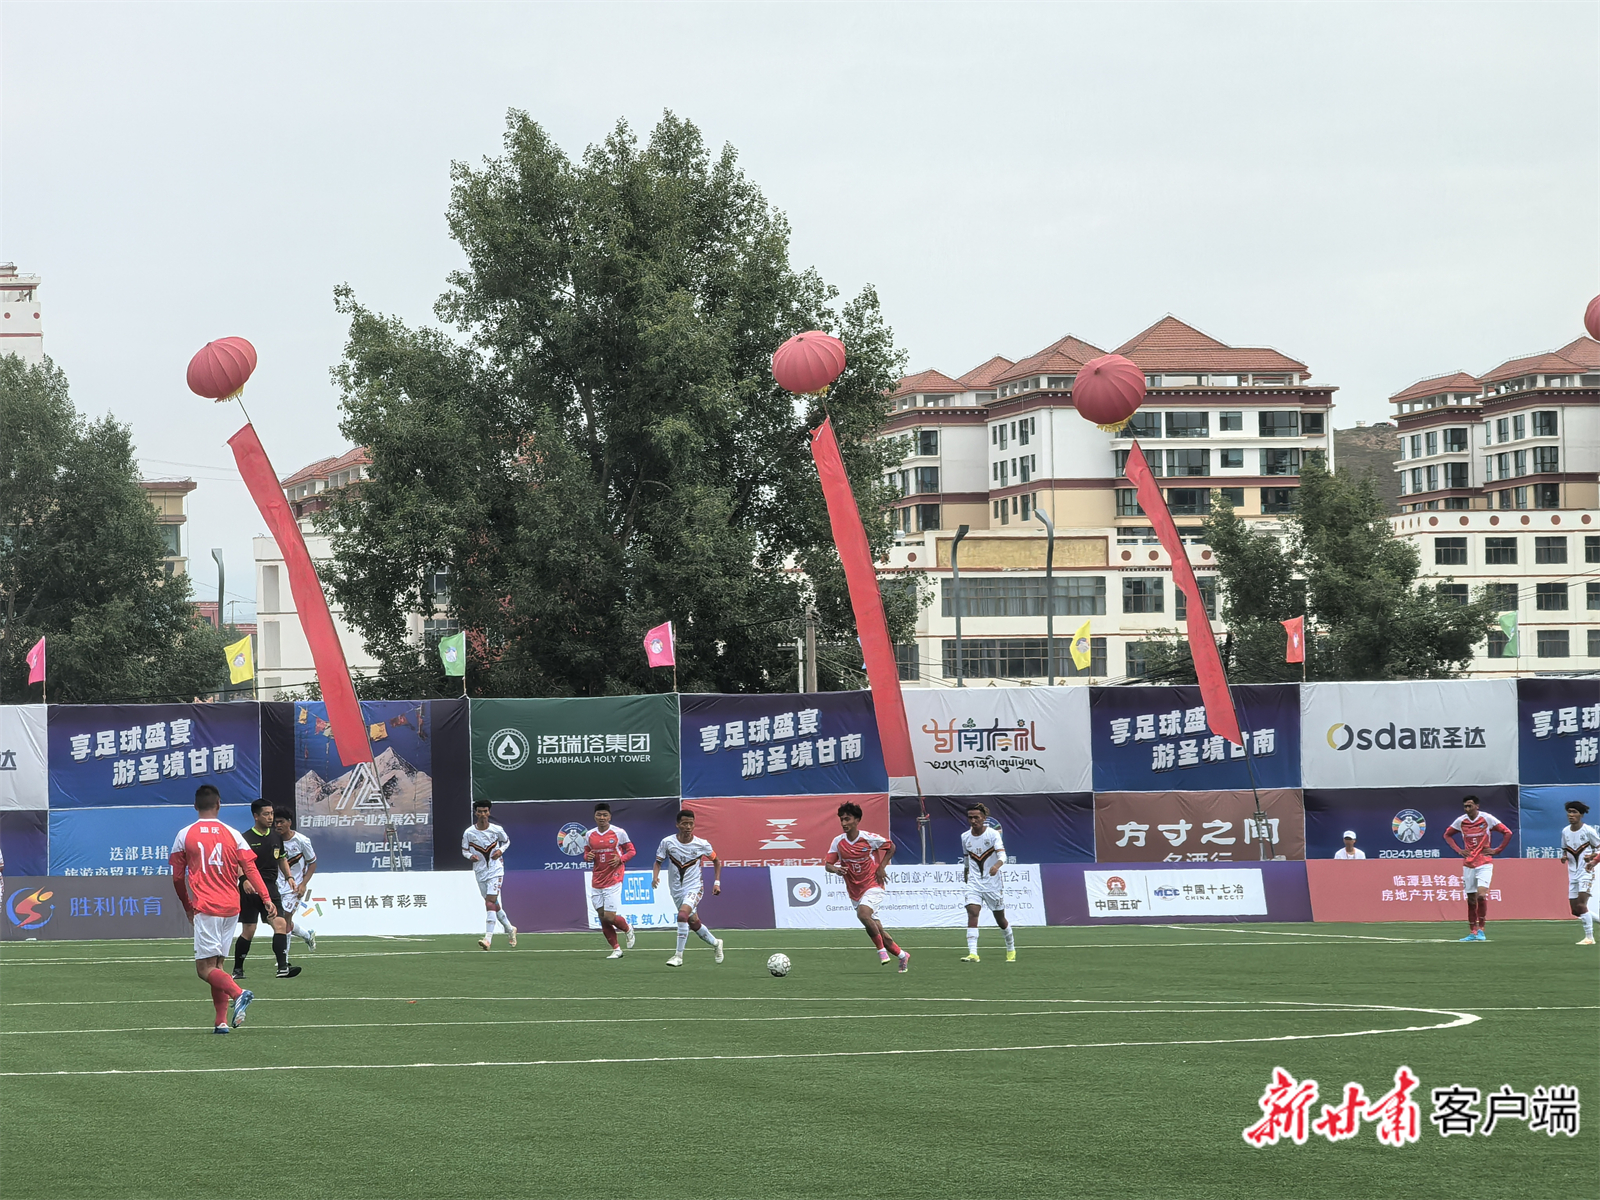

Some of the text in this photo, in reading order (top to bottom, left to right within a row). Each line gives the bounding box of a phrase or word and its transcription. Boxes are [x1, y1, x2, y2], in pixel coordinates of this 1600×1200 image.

[699, 708, 819, 752] 享足球盛宴
[1109, 705, 1208, 745] 享足球盛
[69, 718, 192, 761] 享足球盛宴
[537, 733, 650, 755] 洛瑞塔集团
[1326, 721, 1417, 751] Osda
[1419, 726, 1487, 749] 欧圣达
[112, 743, 235, 787] 游圣境甘南
[536, 754, 651, 764] SHAMBHALA HOLY TOWER
[741, 733, 862, 778] 游圣境甘南
[300, 812, 430, 829] 甘肃阿古产业发展公司
[1115, 818, 1280, 847] 方寸之间
[197, 841, 224, 875] 14
[1379, 849, 1440, 858] 2024九色甘南
[852, 863, 862, 873] 19
[1183, 884, 1244, 895] 中国十七冶
[1393, 875, 1464, 887] 临潭县铭鑫
[332, 894, 428, 910] 中国体育彩票
[1154, 888, 1180, 897] MCC
[69, 896, 163, 917] 胜利体育
[1095, 899, 1142, 911] 中国五矿
